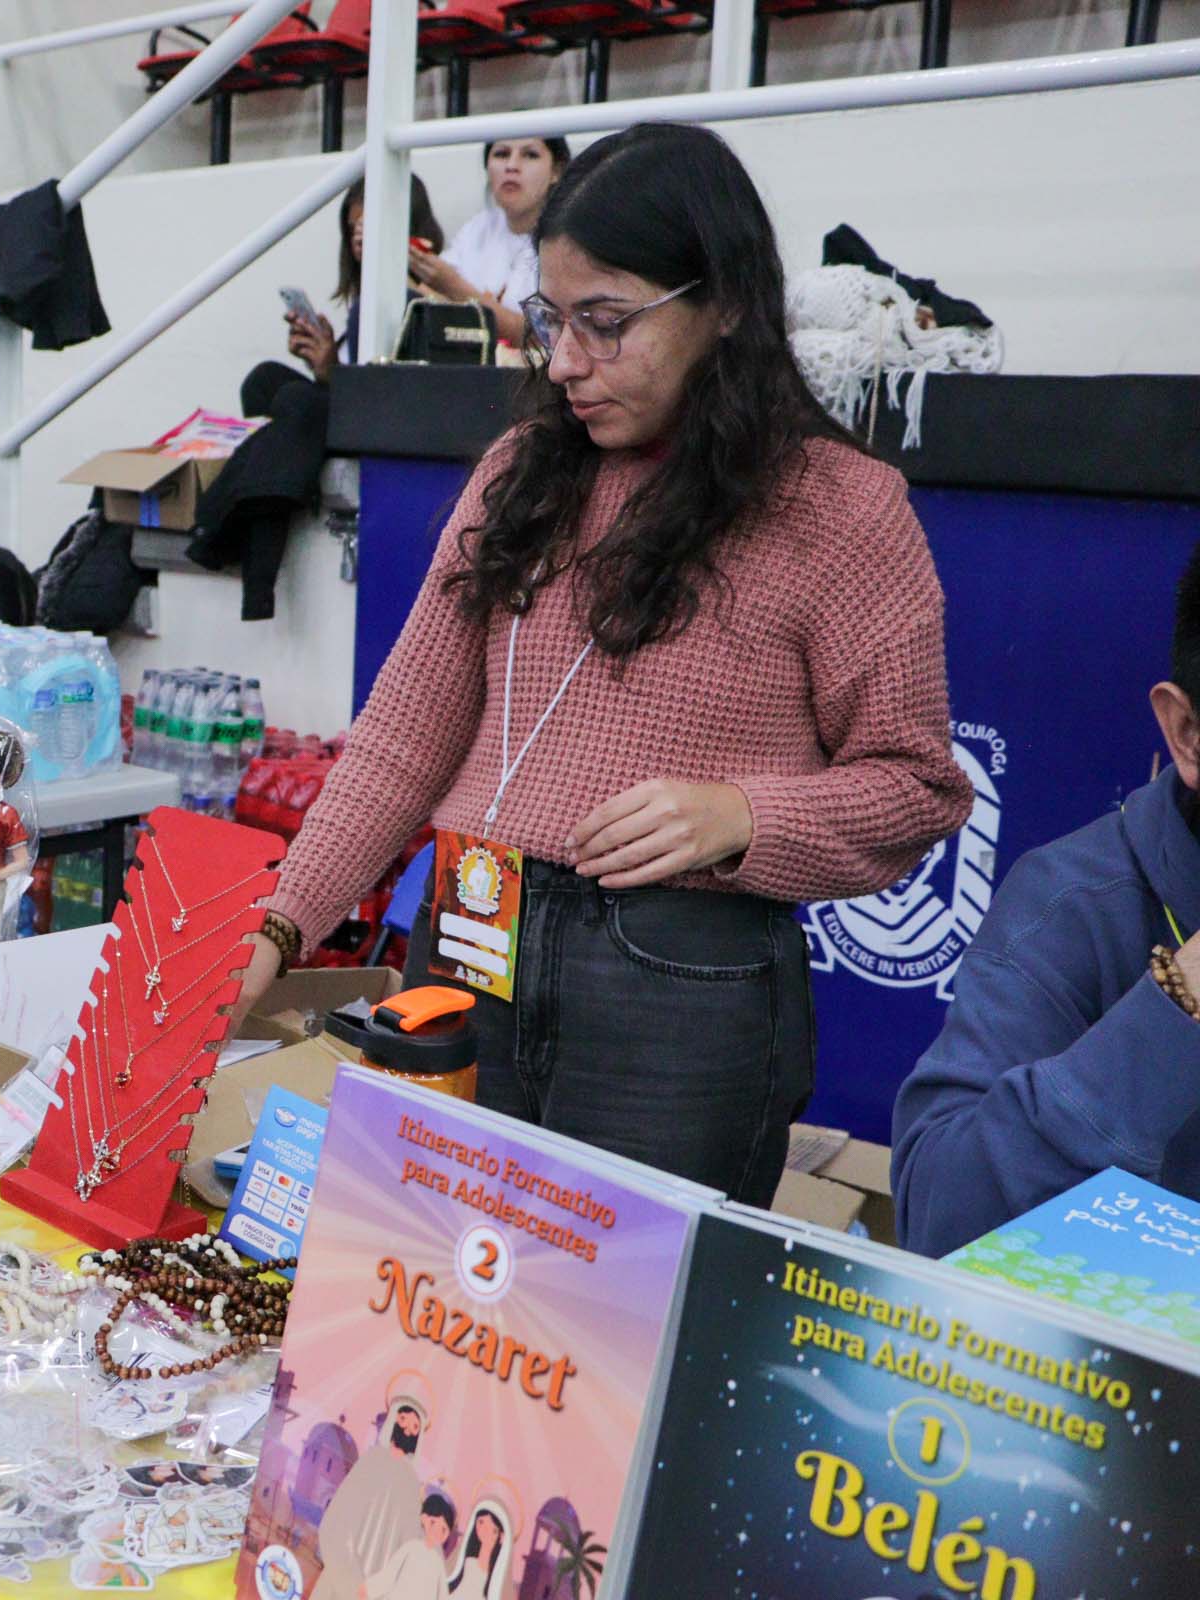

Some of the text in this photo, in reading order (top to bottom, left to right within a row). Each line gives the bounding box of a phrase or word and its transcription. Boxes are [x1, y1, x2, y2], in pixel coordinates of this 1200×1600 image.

[957, 721, 1007, 775] QUIROGA
[823, 913, 960, 977] EDUCERE IN VERITATE
[397, 1113, 616, 1229] Itinerario Formativo
[1115, 1192, 1139, 1211] y
[401, 1159, 598, 1263] para Adolescentes
[1063, 1209, 1129, 1232] por
[1092, 1196, 1120, 1216] lo
[470, 1239, 499, 1282] 2
[368, 1256, 577, 1411] Nazaret
[781, 1262, 1132, 1409] Itinerario Formativo
[790, 1314, 1106, 1450] para Adolescentes
[919, 1415, 942, 1464] 1
[795, 1450, 1036, 1600] Belén
